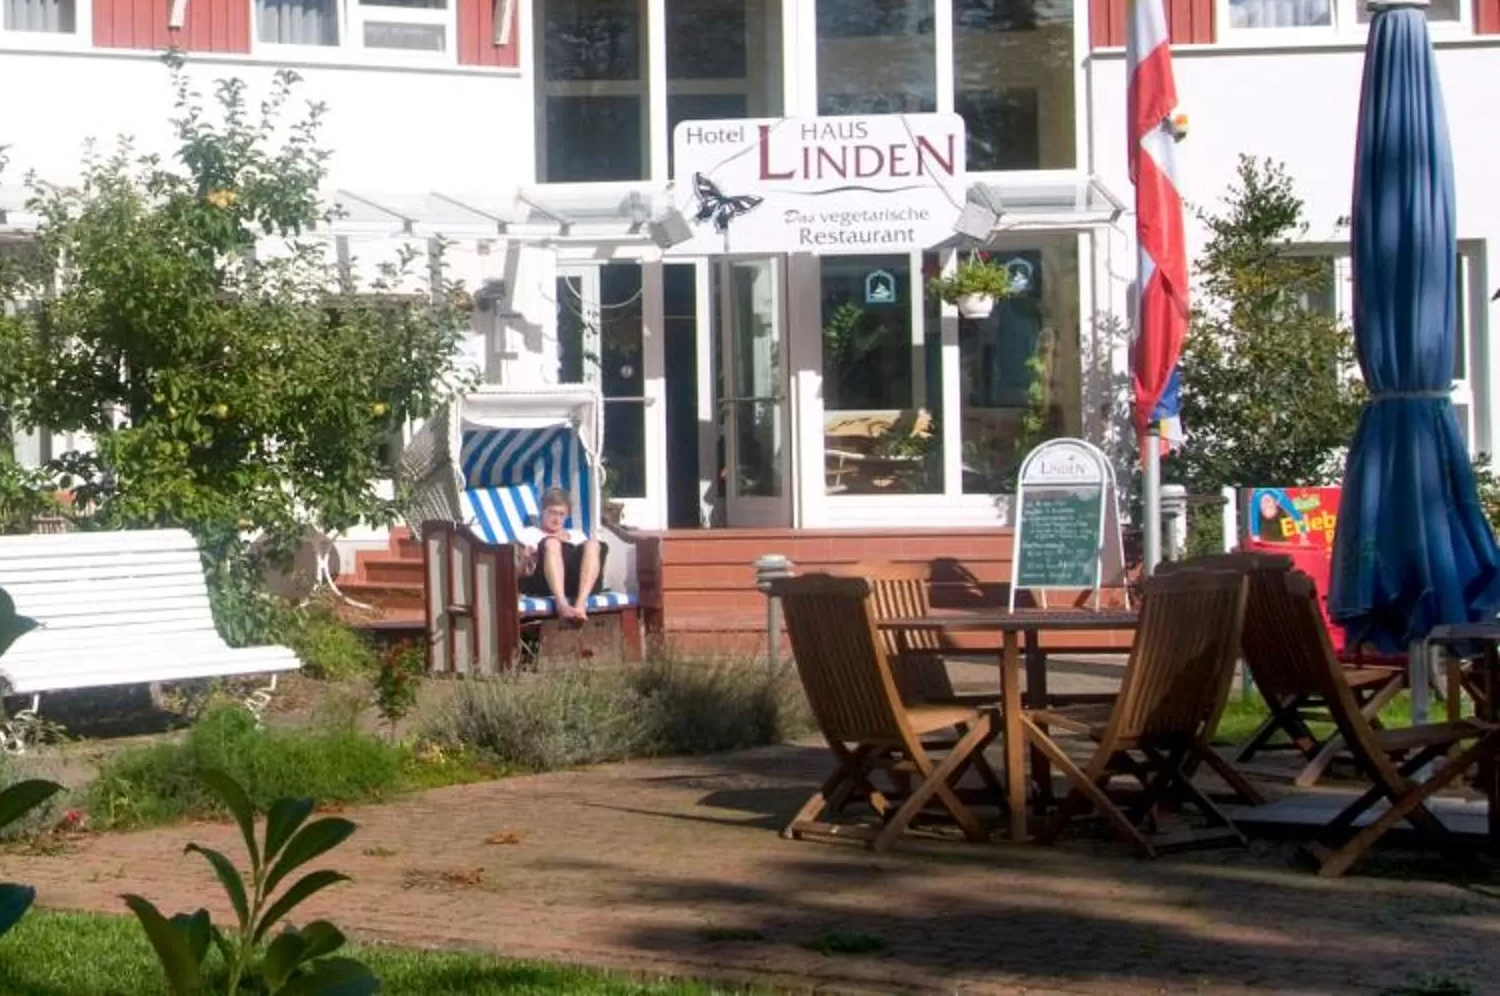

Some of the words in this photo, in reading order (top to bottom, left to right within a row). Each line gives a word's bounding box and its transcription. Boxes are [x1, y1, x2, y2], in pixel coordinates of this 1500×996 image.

[686, 126, 744, 145] Hotel
[801, 121, 868, 140] HAUS
[757, 124, 956, 180] LINDEN
[783, 209, 816, 224] Das
[819, 207, 930, 226] vegetarische
[799, 227, 915, 246] Restaurant
[1281, 511, 1337, 537] Erleb
